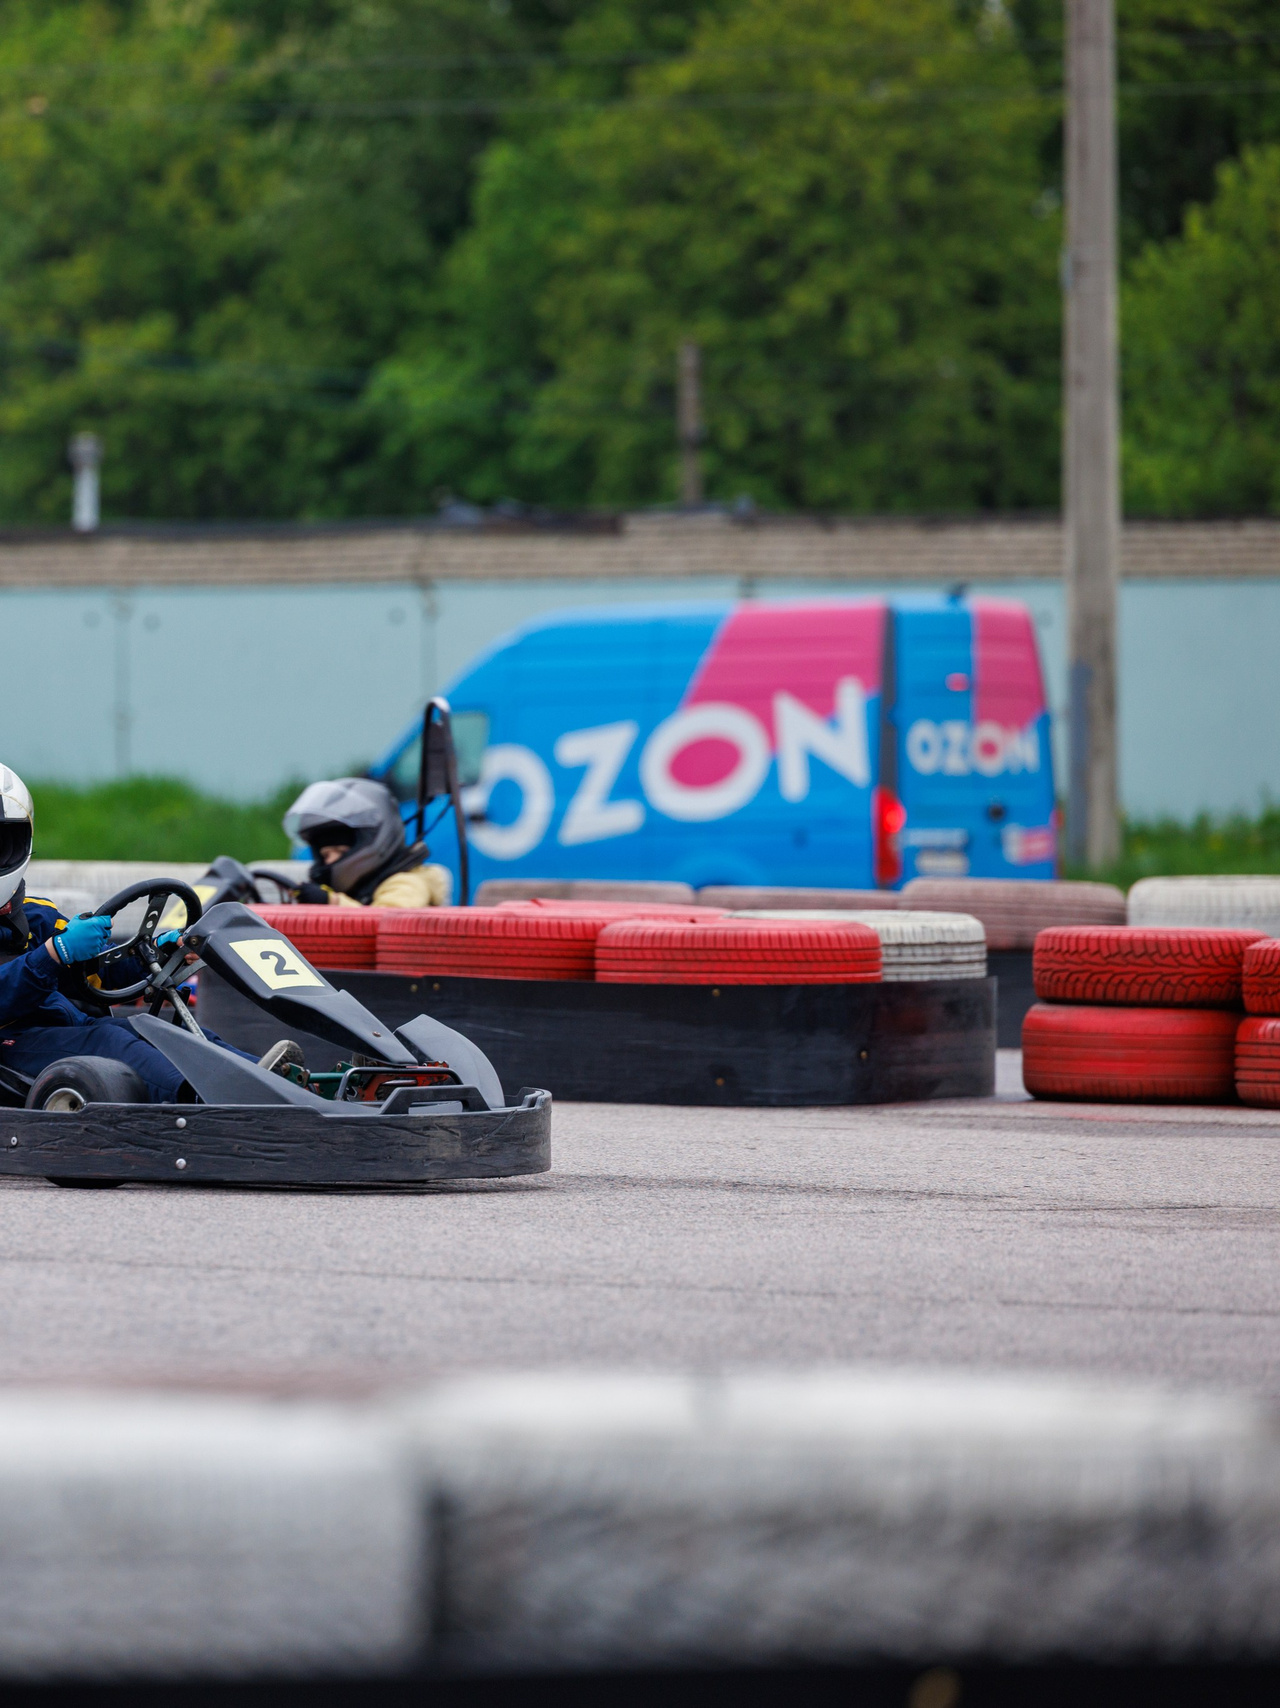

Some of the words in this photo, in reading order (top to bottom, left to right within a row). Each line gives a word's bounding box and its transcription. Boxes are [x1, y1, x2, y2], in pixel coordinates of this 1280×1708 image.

[466, 676, 871, 861] OZON
[906, 718, 1041, 778] OZON
[260, 951, 300, 976] 2
